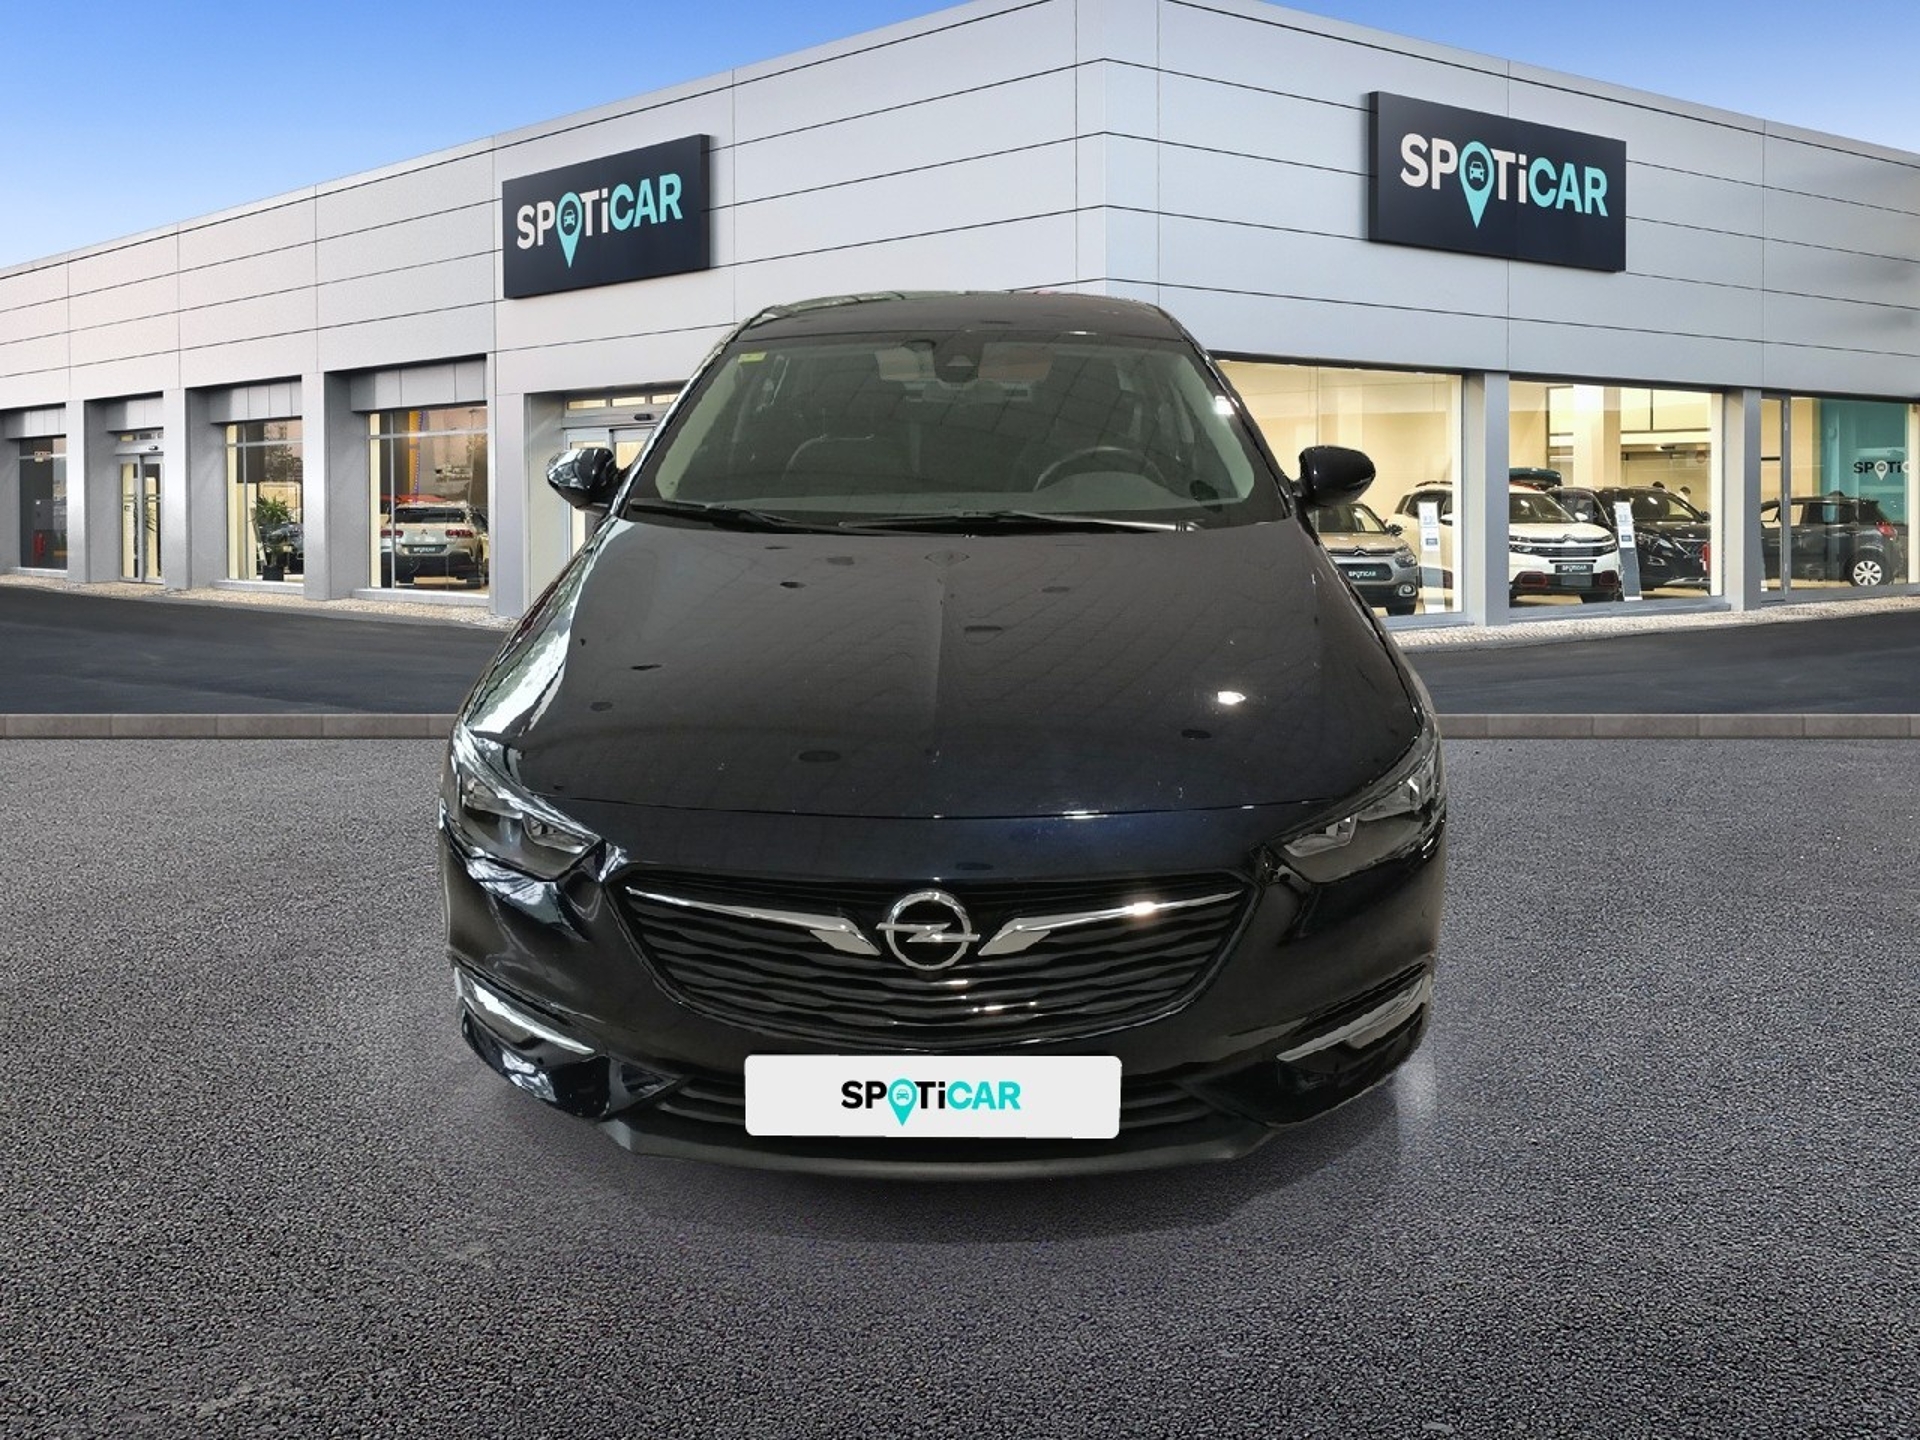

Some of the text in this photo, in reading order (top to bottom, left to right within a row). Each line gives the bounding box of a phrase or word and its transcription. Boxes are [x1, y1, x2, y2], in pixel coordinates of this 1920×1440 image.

[516, 173, 683, 268] SPOTiCAR
[1400, 133, 1608, 229] SPOTiCAR
[841, 1077, 1021, 1127] SPOTiCAR
